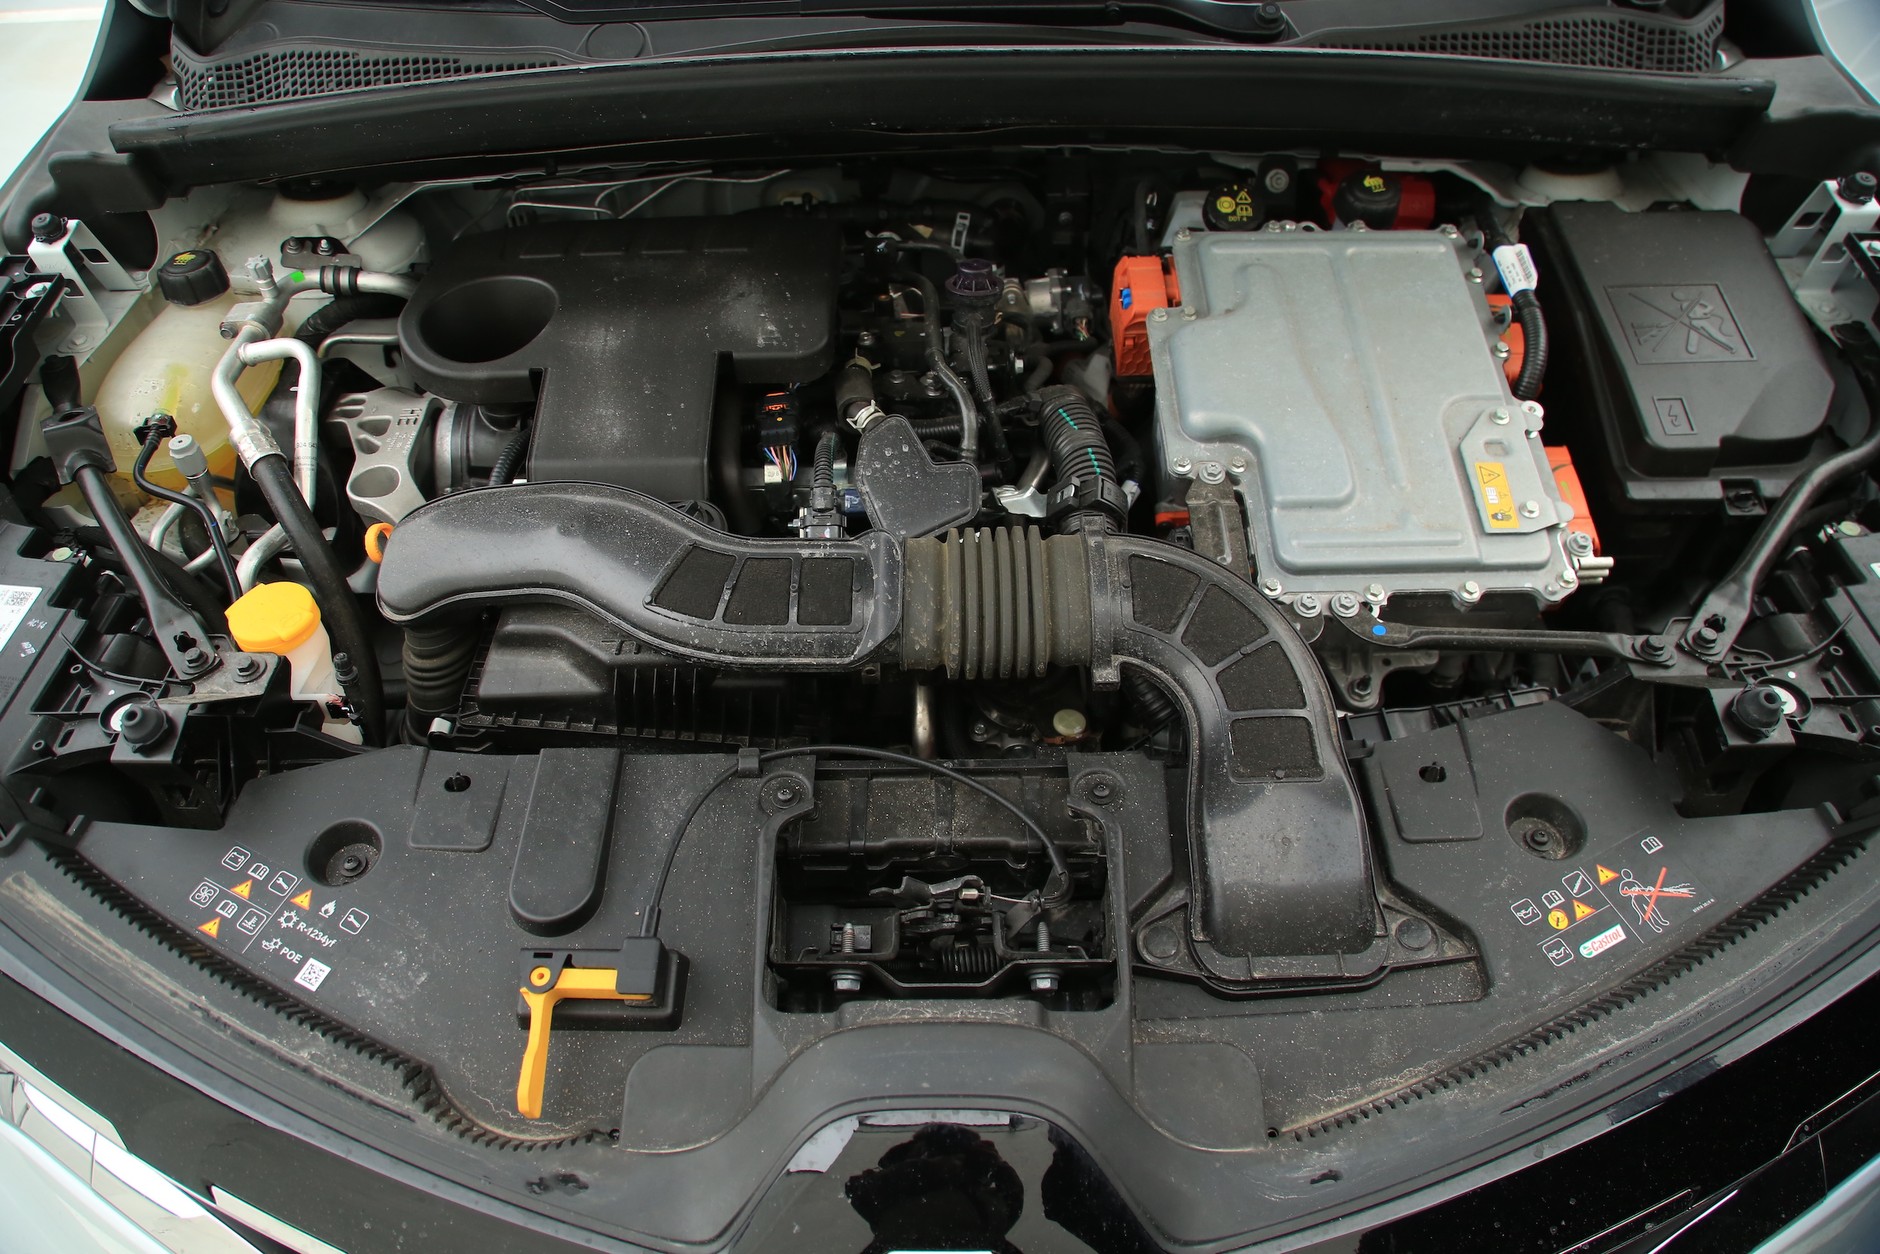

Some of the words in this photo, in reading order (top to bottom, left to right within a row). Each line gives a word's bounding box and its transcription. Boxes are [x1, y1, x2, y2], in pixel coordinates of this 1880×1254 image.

[296, 921, 338, 948] R-1234yf
[1590, 928, 1622, 951] Castrol
[280, 946, 303, 964] POE
